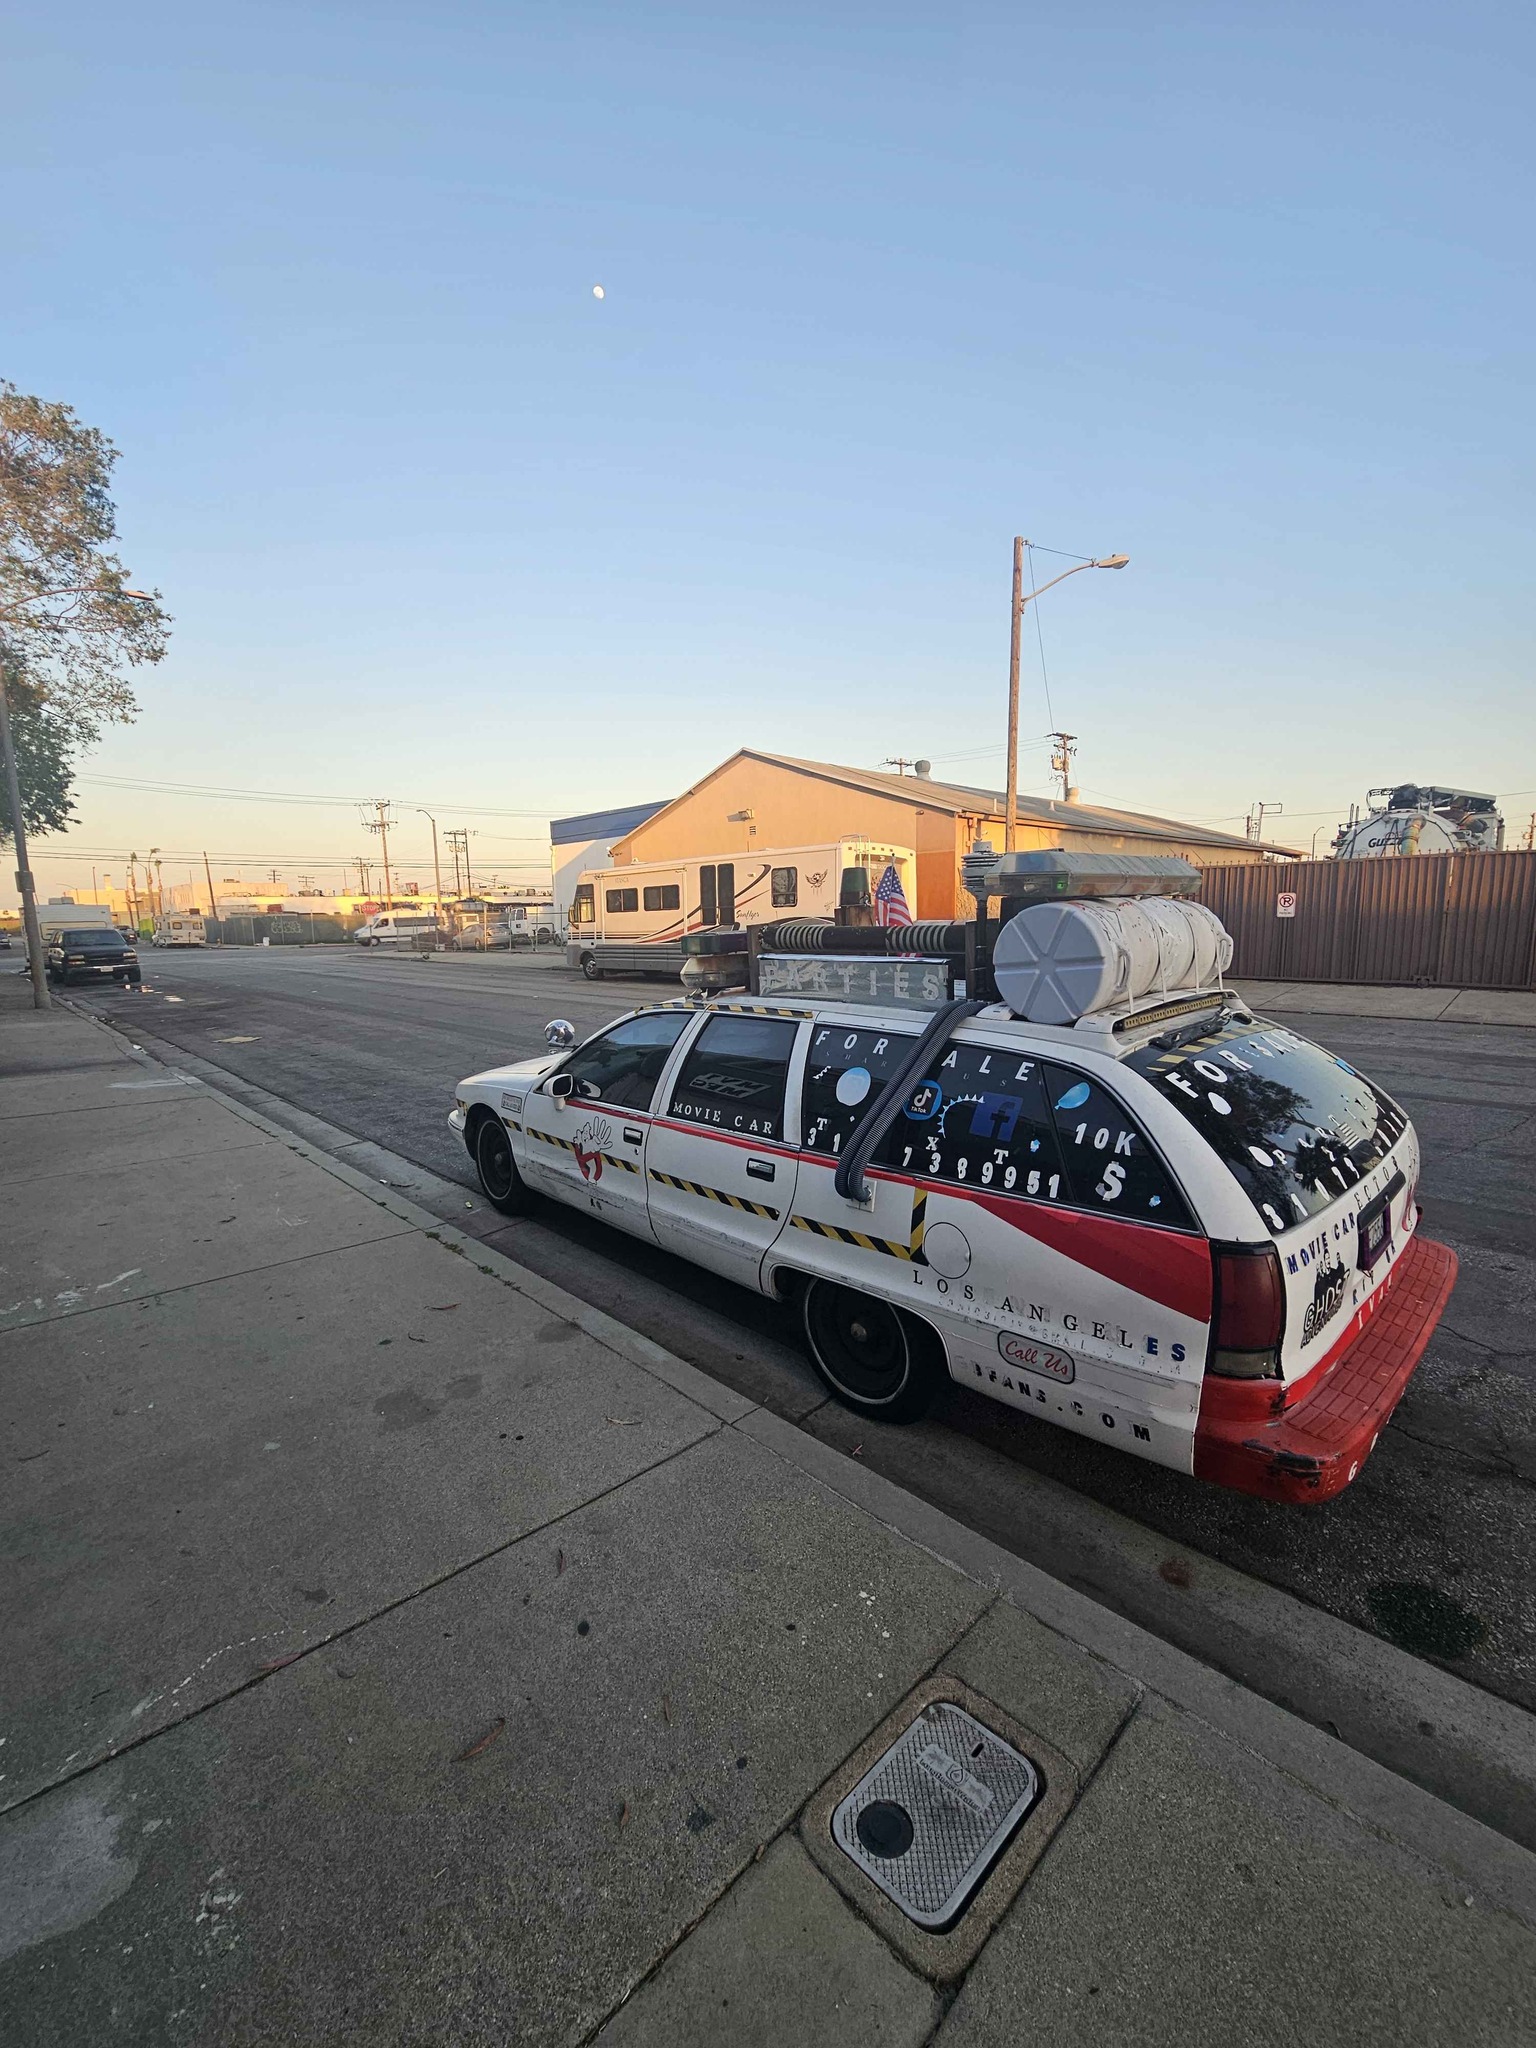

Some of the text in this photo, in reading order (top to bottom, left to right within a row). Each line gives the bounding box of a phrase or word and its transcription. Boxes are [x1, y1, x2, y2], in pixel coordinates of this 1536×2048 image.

[815, 1030, 1036, 1082] FOR ALE
[825, 1051, 888, 1068] SHAR
[1164, 1050, 1253, 1099] FOR
[673, 1101, 773, 1135] MOVIE CAR
[910, 1106, 927, 1114] TikTok
[1075, 1122, 1136, 1156] 10K
[1286, 1230, 1329, 1275] MOVIE
[1332, 1212, 1356, 1241] CAR
[913, 1269, 975, 1300] LOS
[1001, 1296, 1186, 1362] ANGELES
[1304, 1268, 1350, 1333] GHOST
[1005, 1340, 1069, 1376] Call Us
